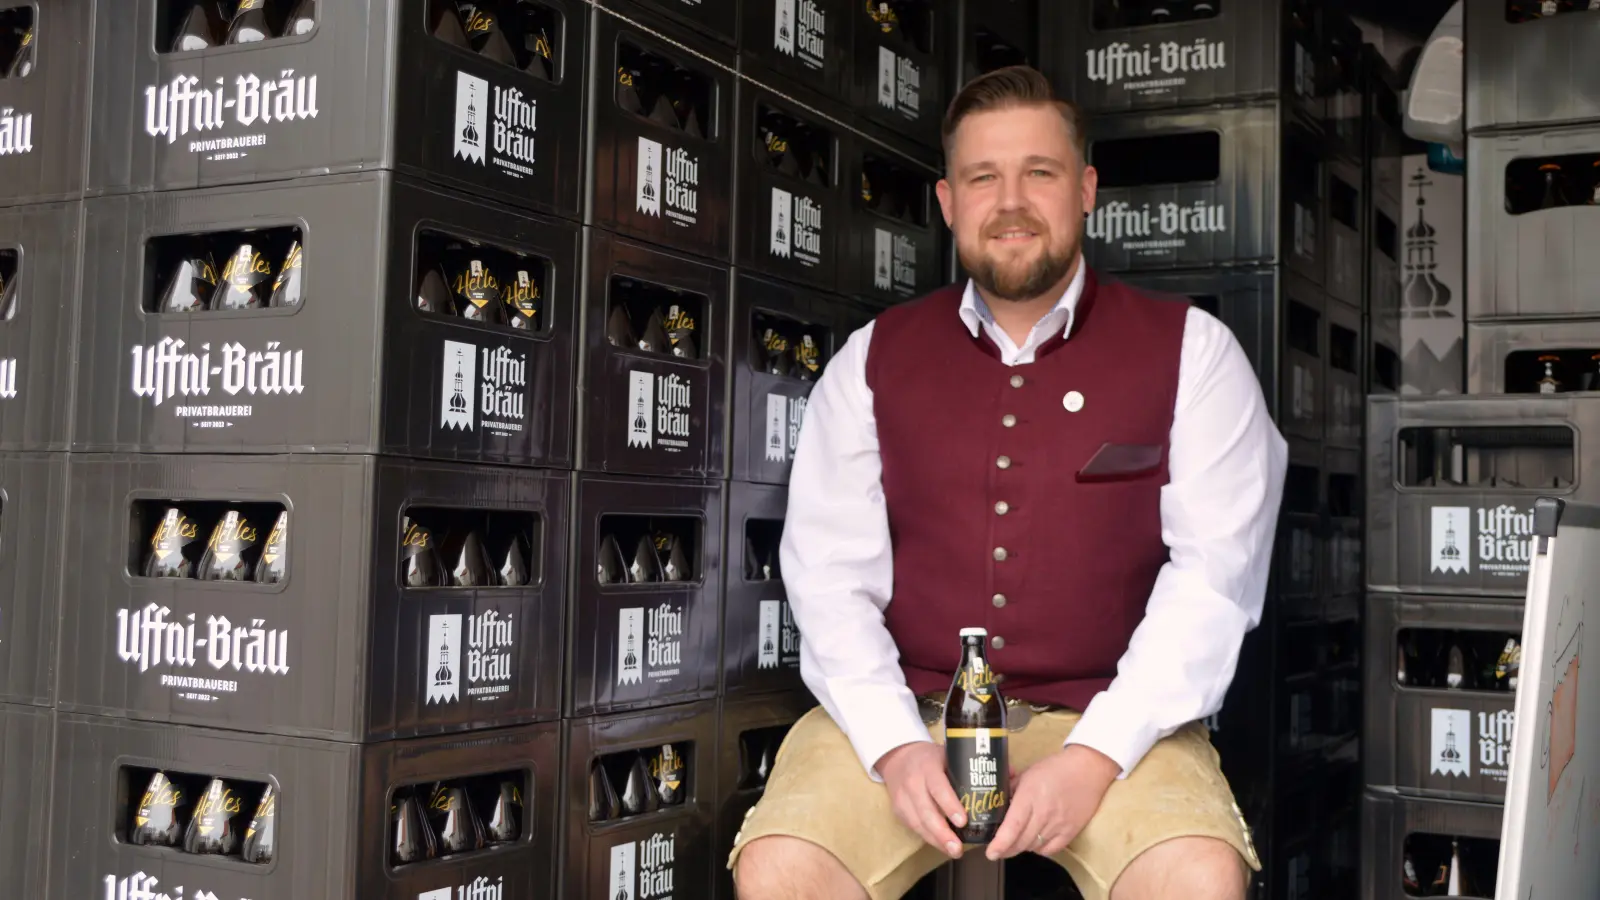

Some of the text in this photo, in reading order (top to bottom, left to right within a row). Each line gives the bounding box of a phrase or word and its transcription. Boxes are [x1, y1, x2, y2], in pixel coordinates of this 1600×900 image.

[798, 0, 826, 35] Uffni
[798, 23, 825, 60] Bräu
[1085, 38, 1227, 86] Uffni-Bräu
[144, 68, 319, 144] Uffni-Bräu
[492, 85, 537, 132] Uffni
[189, 133, 267, 153] PRIVATBRAUEREI
[492, 119, 536, 165] Bräu
[492, 156, 535, 177] PRIVATBRAUEREI
[665, 147, 699, 186] Uffni
[664, 176, 698, 214] Bräu
[794, 195, 822, 230] Uffni
[794, 222, 822, 255] Bräu
[1086, 199, 1226, 244] Uffni-Bräu
[131, 335, 306, 406] Uffni-Bräu
[482, 344, 526, 388] Uffni
[481, 381, 525, 420] Bräu
[657, 372, 691, 412] Uffni
[175, 404, 253, 418] PRIVATBRAUEREI
[481, 420, 523, 432] PRIVATBRAUEREI
[657, 404, 690, 438] Bräu
[116, 601, 291, 676] Uffni-Bräu
[468, 608, 514, 653] Uffni
[648, 602, 682, 642] Uffni
[467, 648, 512, 684] Bräu
[648, 638, 682, 668] Bräu
[161, 673, 238, 692] PRIVATBRAUEREI
[467, 685, 510, 697] PRIVATBRAUEREI
[1478, 708, 1516, 744] Uff
[969, 756, 998, 774] Uffni
[969, 771, 998, 787] Bräu
[960, 788, 1005, 821] Helles
[640, 832, 675, 873] Uffni
[640, 864, 674, 900] Bräu
